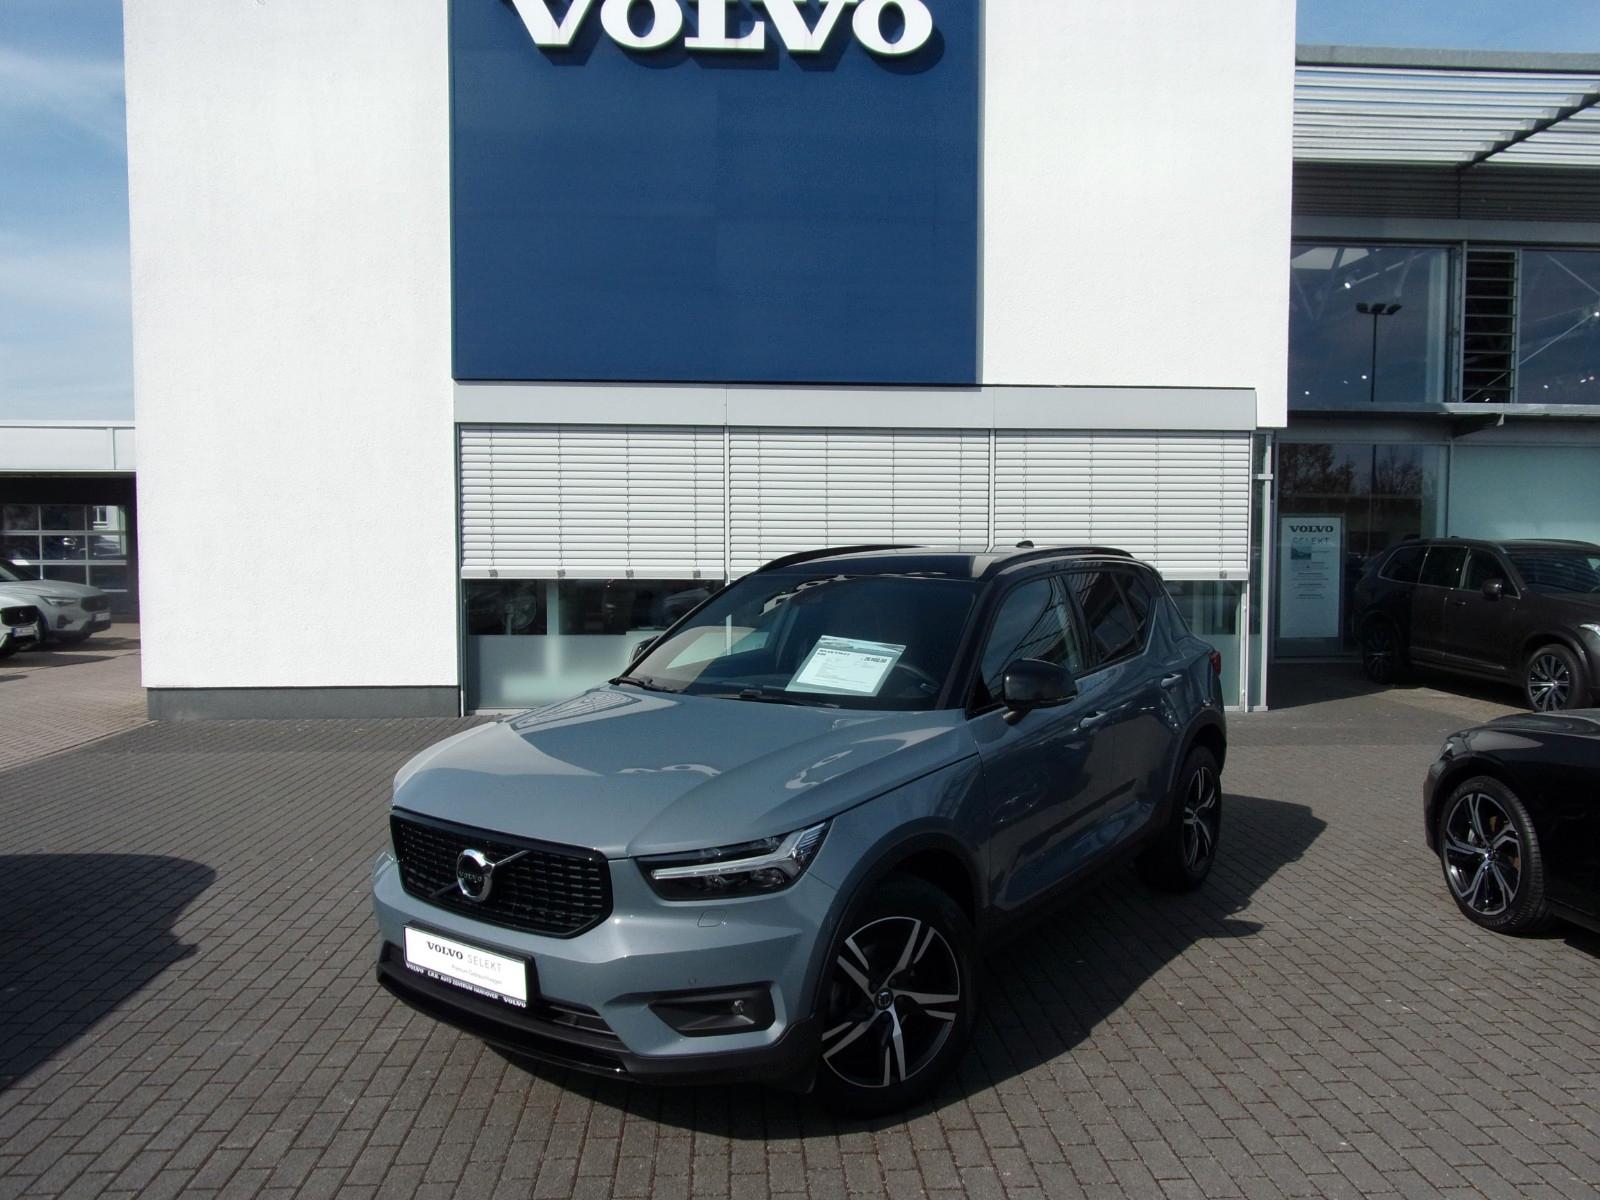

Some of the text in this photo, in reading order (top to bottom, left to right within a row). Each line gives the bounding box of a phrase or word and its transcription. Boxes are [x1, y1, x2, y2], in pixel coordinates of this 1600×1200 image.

[511, 0, 934, 55] VOLVO
[1288, 525, 1334, 533] VOLVO
[426, 941, 464, 960] VOLVO
[467, 954, 502, 973] SELEKT
[406, 961, 424, 974] VOLVO
[502, 995, 527, 1008] VOLVO
